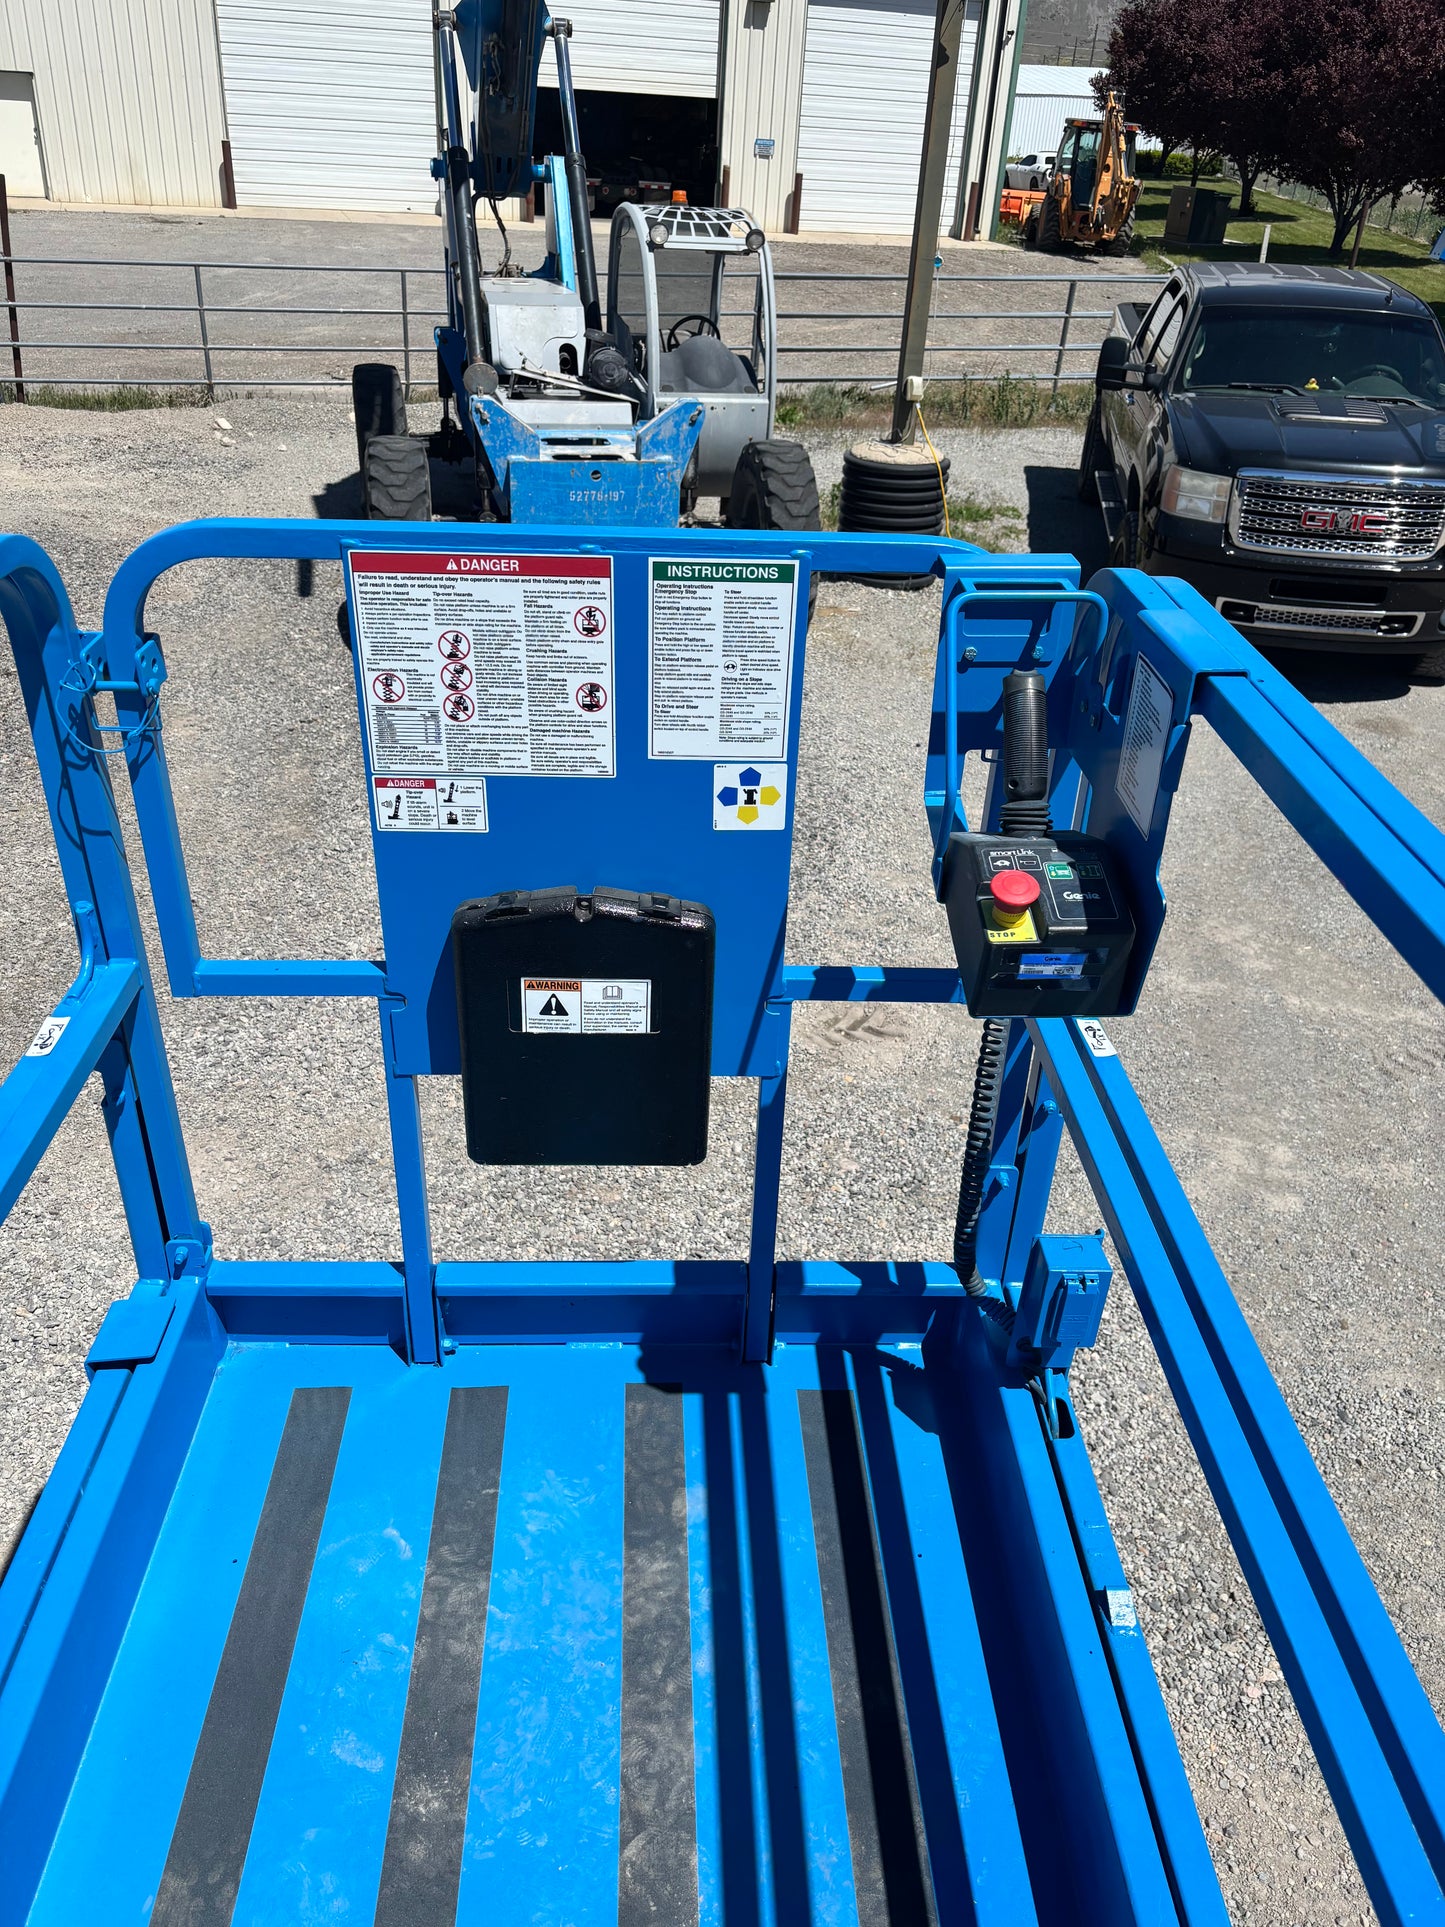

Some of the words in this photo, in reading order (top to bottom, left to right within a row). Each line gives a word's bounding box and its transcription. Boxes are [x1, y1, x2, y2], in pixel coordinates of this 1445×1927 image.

[460, 558, 519, 572] DANGER
[667, 565, 779, 579] INSTRUCTIONS
[1063, 891, 1101, 900] Genie
[536, 982, 579, 990] WARNING
